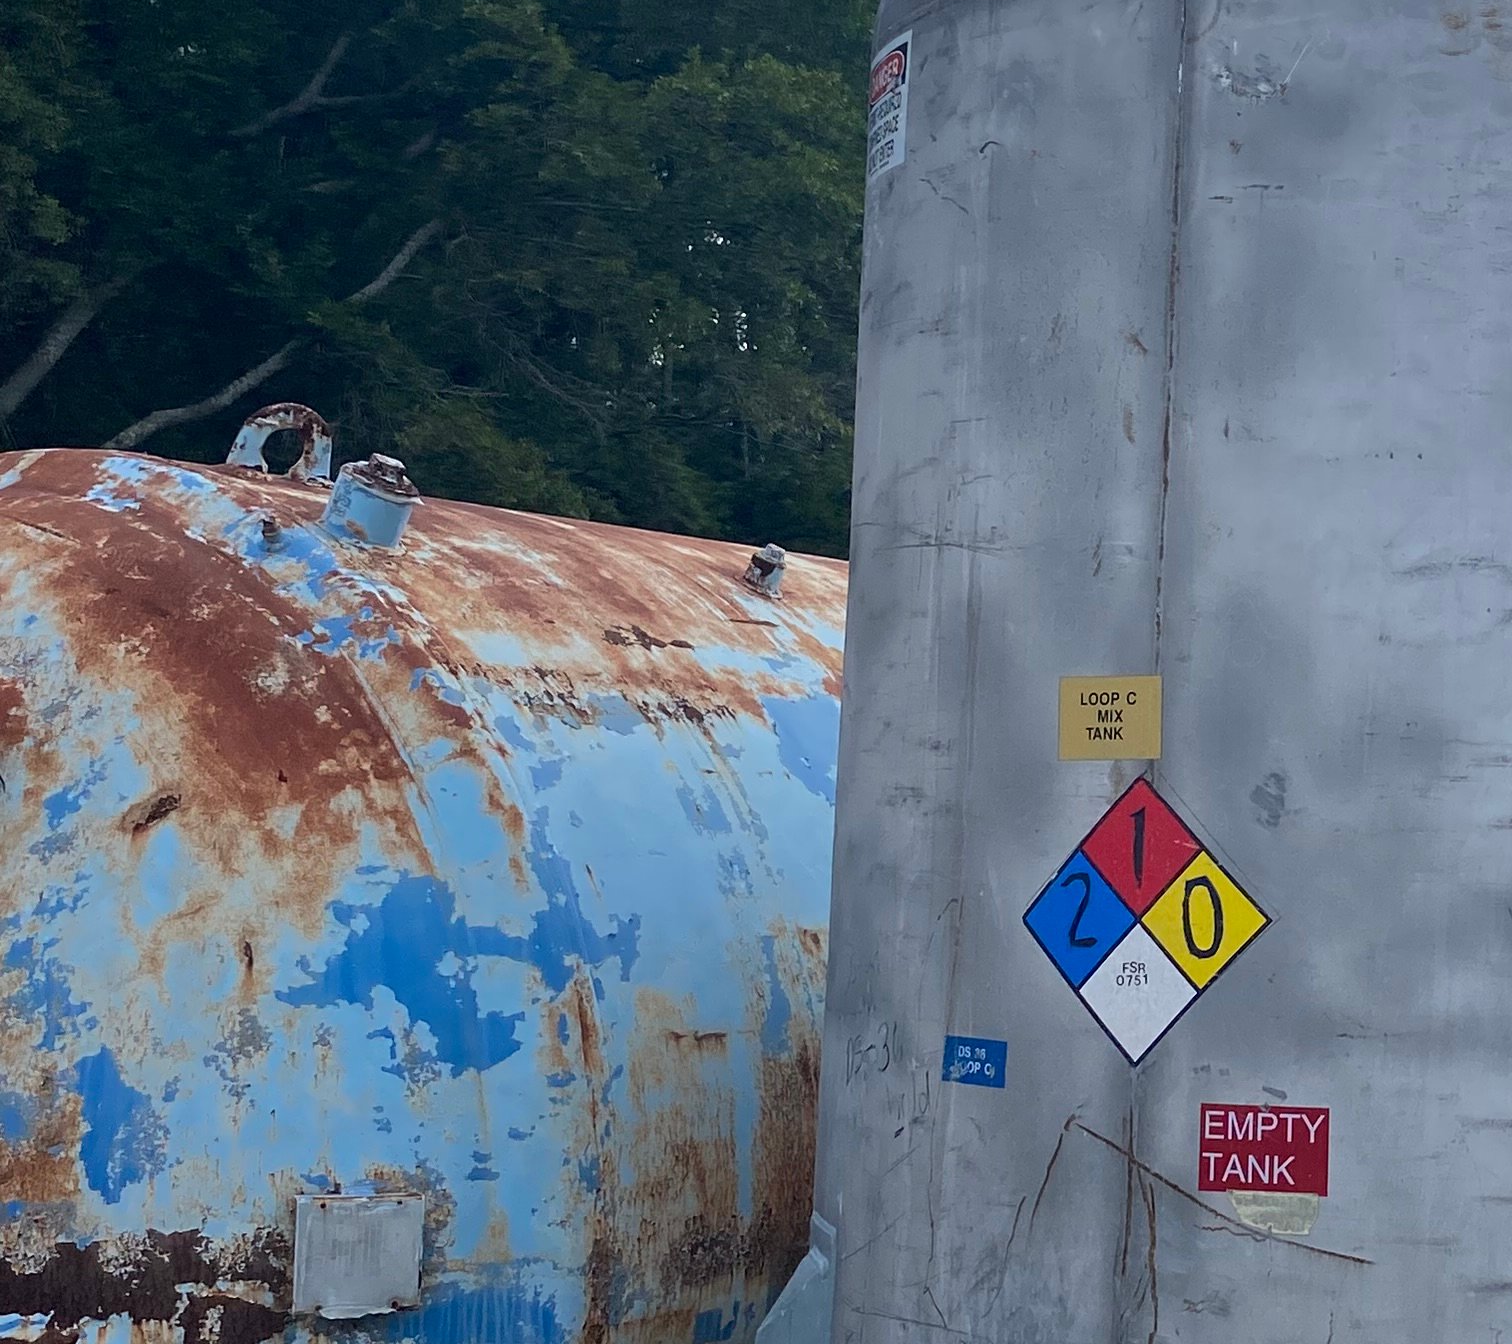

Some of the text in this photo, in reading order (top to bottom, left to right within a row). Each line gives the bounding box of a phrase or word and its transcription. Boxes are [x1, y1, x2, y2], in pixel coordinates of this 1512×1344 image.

[1080, 691, 1137, 706] LOOP C
[1097, 709, 1124, 723] MIX
[1085, 727, 1124, 741] TANK
[1130, 806, 1146, 890] 1
[1061, 872, 1224, 959] 2 0
[1121, 961, 1147, 974] FSR
[1116, 974, 1149, 987] 0751
[958, 1045, 971, 1058] DS
[1204, 1110, 1326, 1144] EMPTY
[1202, 1152, 1296, 1186] TANK
